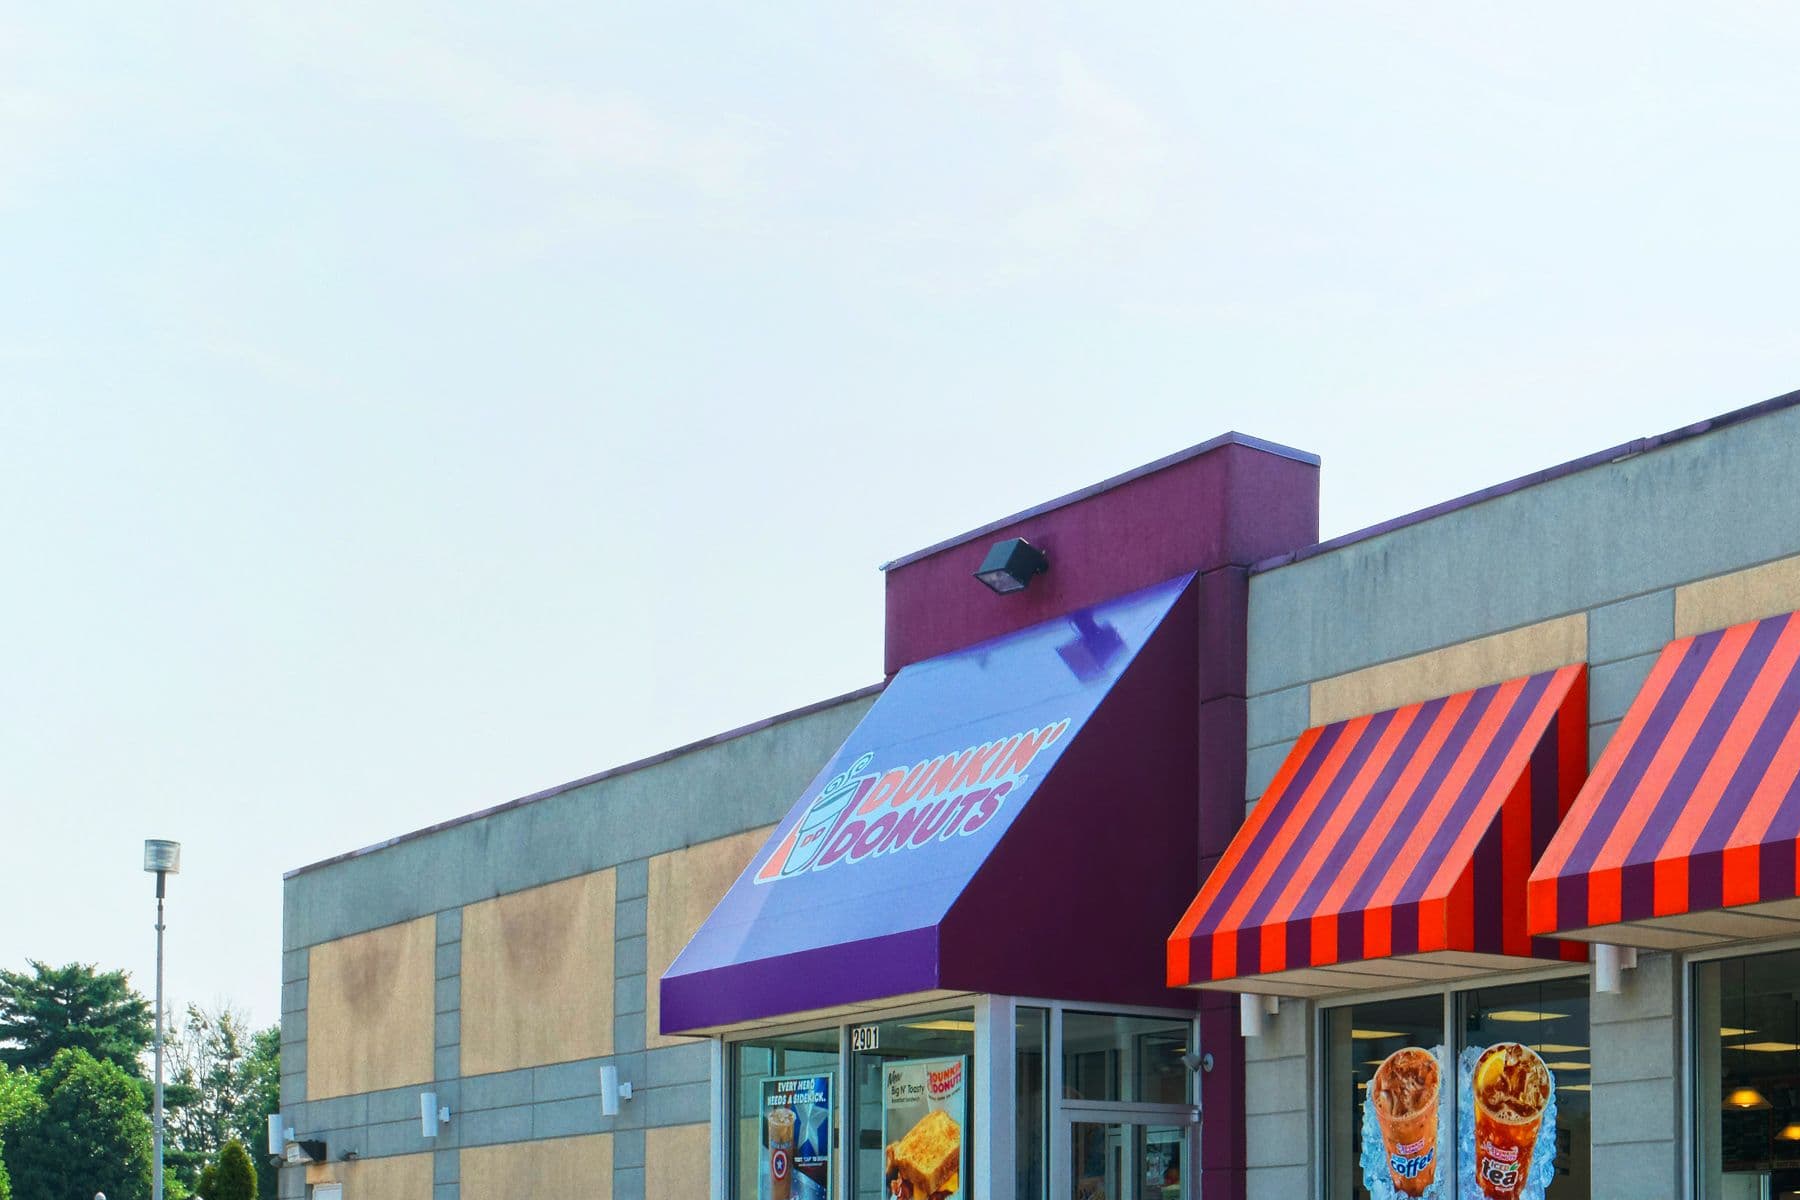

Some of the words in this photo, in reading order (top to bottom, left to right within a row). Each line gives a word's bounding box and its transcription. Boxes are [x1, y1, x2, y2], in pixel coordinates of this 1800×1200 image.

[856, 720, 1068, 817] DUNKIN'
[816, 780, 1014, 867] DONUTS
[853, 1027, 879, 1050] 2901
[778, 1080, 797, 1093] EVERY
[767, 1095, 786, 1106] NEEDS
[787, 1094, 792, 1105] A
[1482, 1159, 1517, 1186] tea
[1490, 1160, 1510, 1171] ICED
